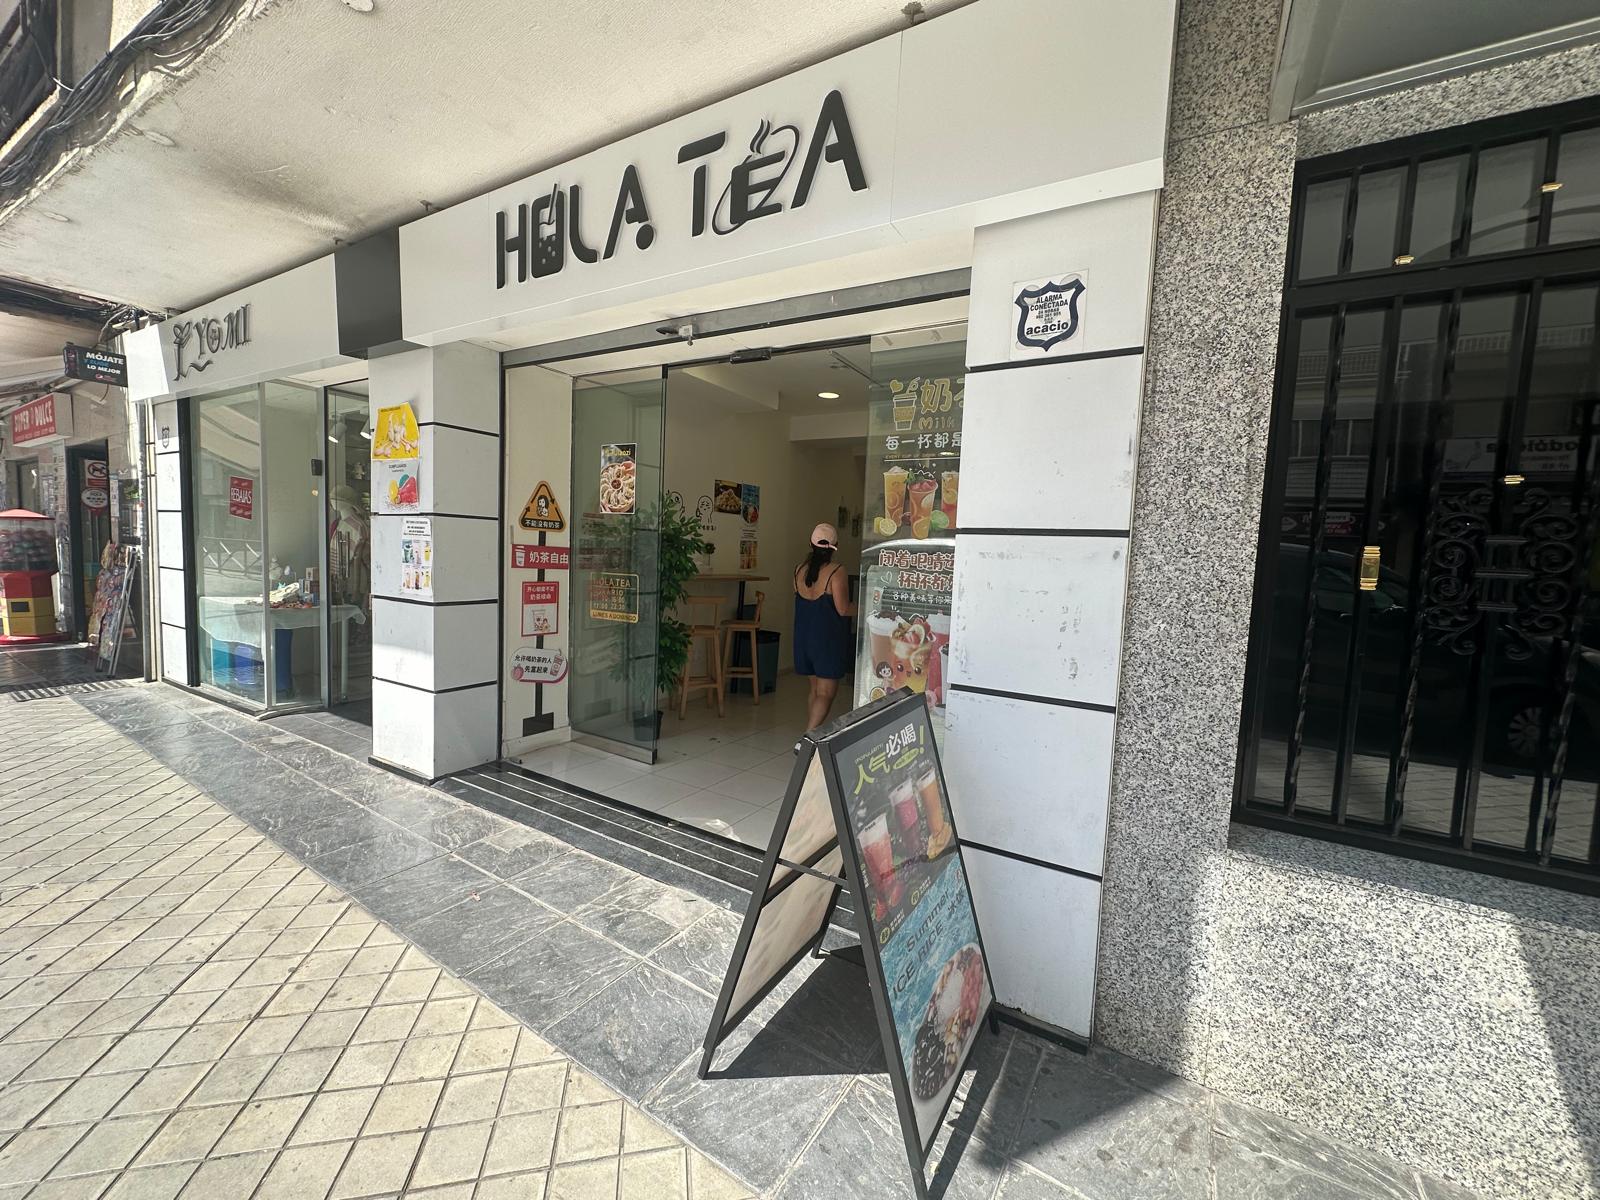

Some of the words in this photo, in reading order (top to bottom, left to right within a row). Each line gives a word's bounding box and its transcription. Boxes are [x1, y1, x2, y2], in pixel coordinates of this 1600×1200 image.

[496, 164, 653, 289] HOLA
[678, 89, 869, 237] TEA
[1037, 294, 1062, 303] ALARMA
[1030, 300, 1068, 311] CONECTADA
[1026, 321, 1068, 335] acacio
[86, 352, 124, 365] MÓJATE
[98, 367, 121, 375] MEJOR
[886, 432, 962, 451] 每一杯都是
[524, 519, 560, 529] 不能没有奶茶
[529, 551, 569, 564] 奶茶自由
[906, 889, 950, 952] Summer
[892, 958, 917, 999] ICE
[917, 919, 944, 962] RICE
